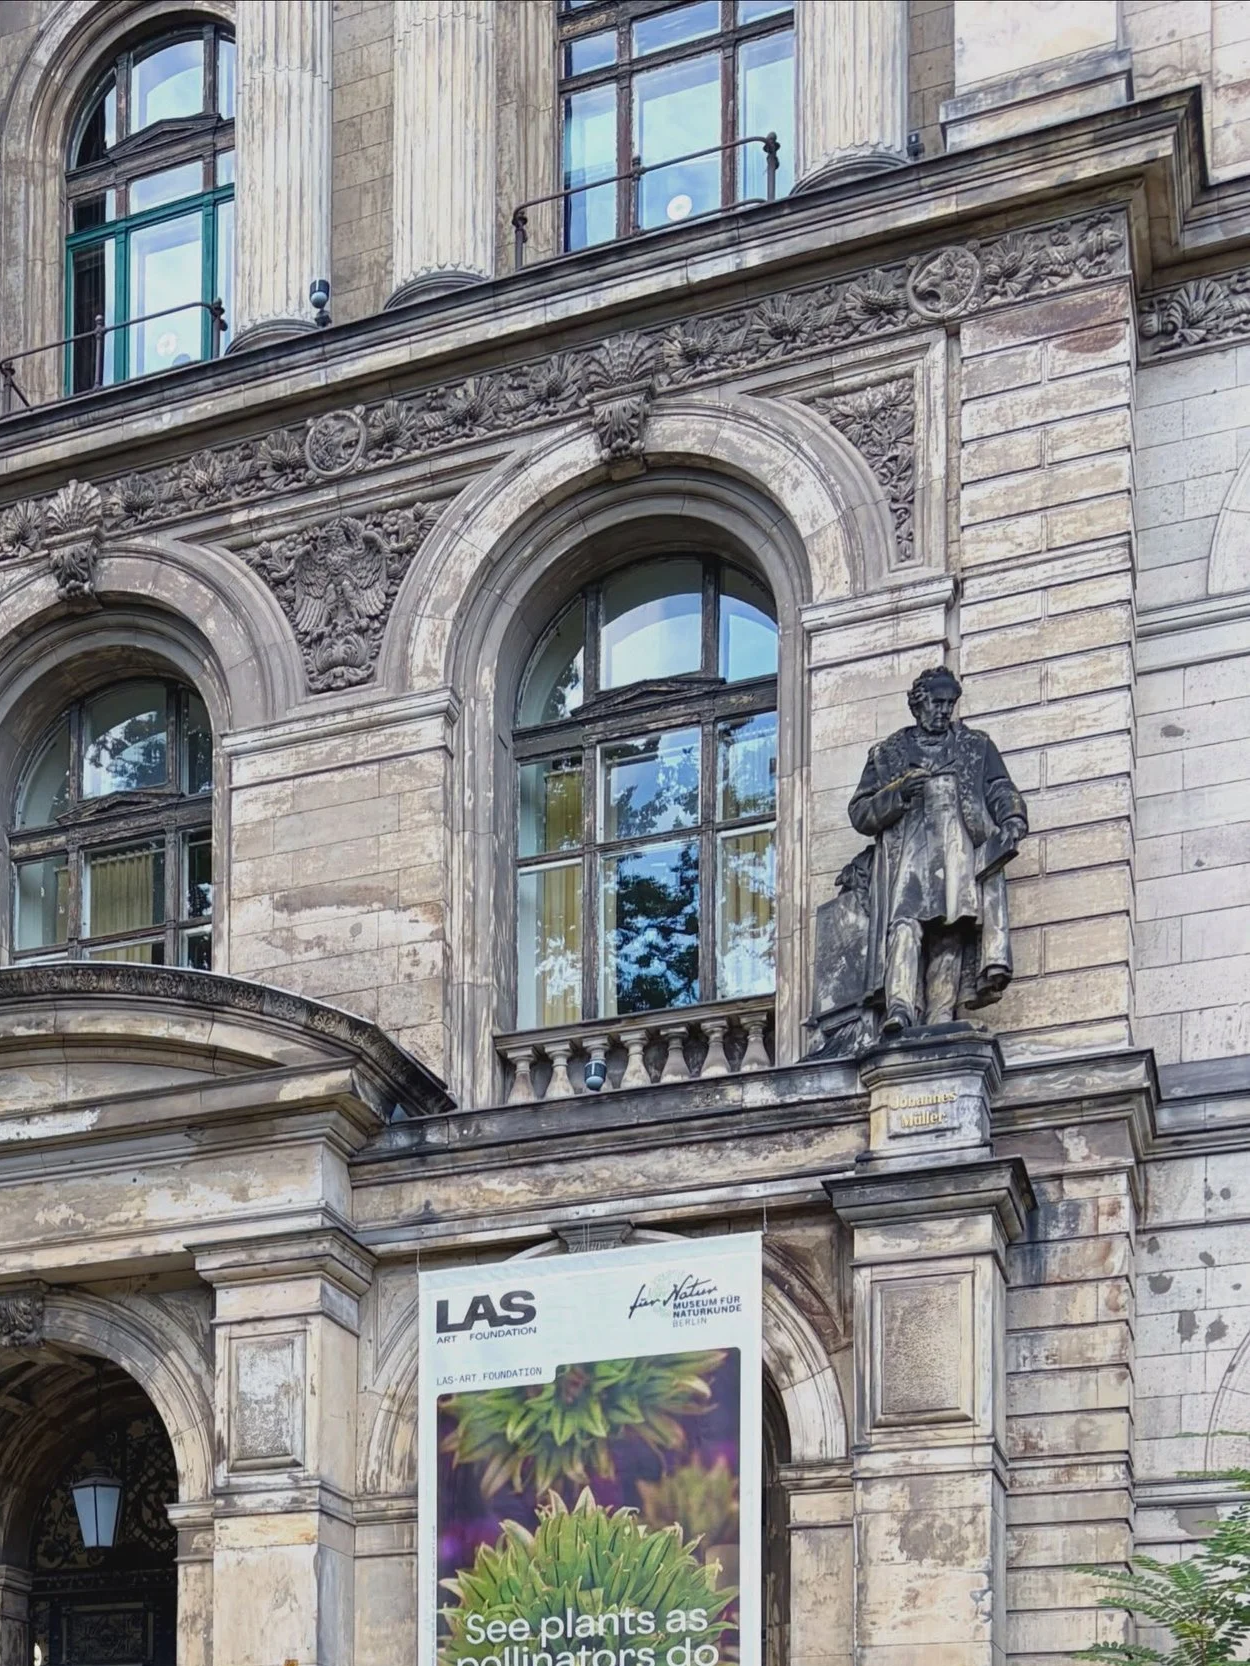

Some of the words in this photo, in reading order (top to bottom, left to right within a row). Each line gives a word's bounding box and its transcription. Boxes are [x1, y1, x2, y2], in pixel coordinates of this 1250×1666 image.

[673, 1299, 717, 1311] MUSEUM
[720, 1295, 741, 1305] FÜR
[673, 1304, 742, 1319] NATURKUNDE
[436, 1290, 537, 1334] LAS
[673, 1317, 708, 1329] BERLIN
[436, 1335, 457, 1345] ART
[469, 1326, 537, 1341] FOUNDATION
[466, 1614, 530, 1645] See
[541, 1606, 655, 1648] plants
[665, 1607, 708, 1633] as
